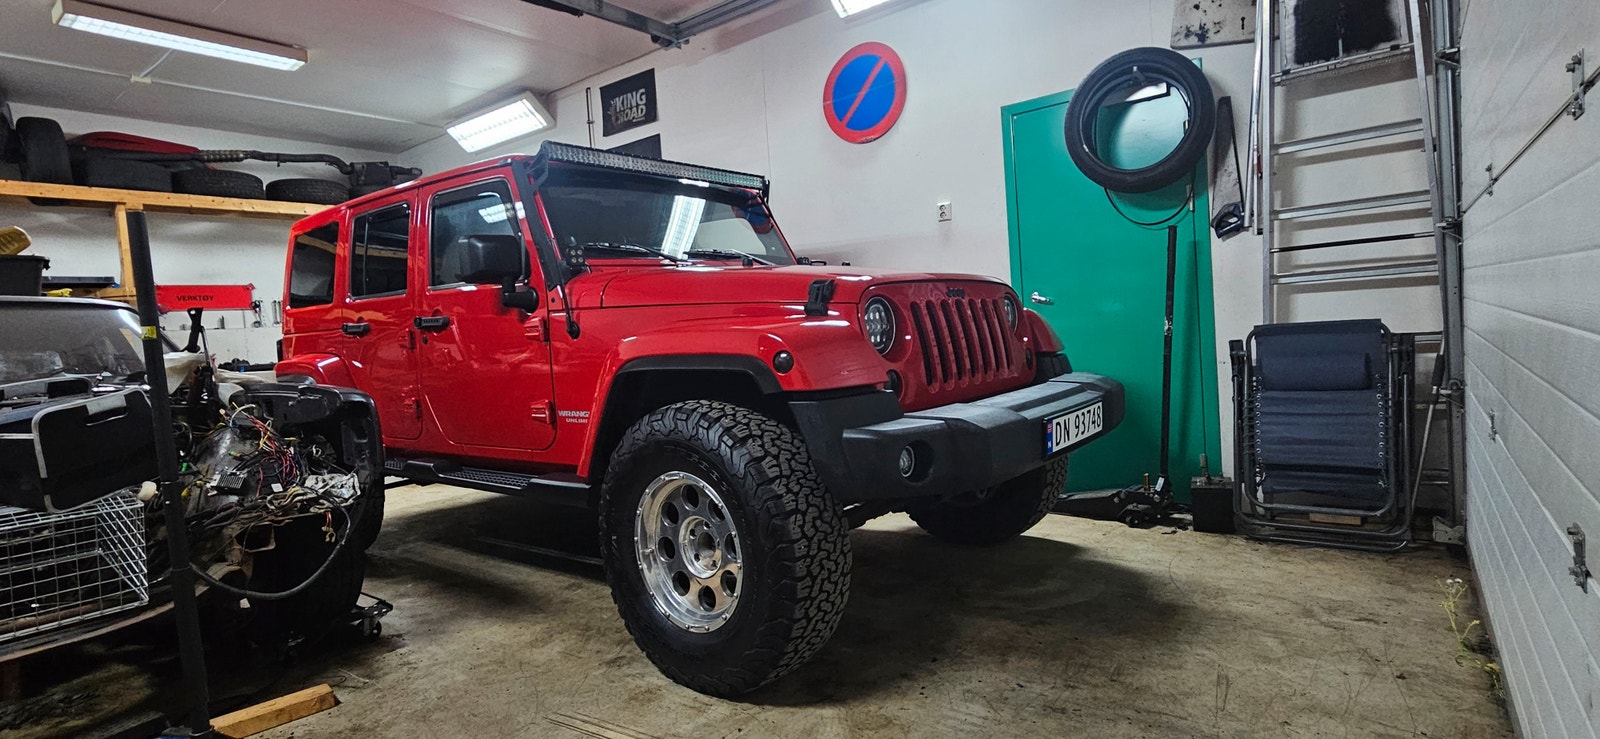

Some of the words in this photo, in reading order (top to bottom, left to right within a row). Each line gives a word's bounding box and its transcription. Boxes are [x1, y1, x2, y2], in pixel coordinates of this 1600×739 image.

[616, 88, 646, 112] KING
[1055, 417, 1070, 446] DN
[1074, 405, 1101, 438] 93748
